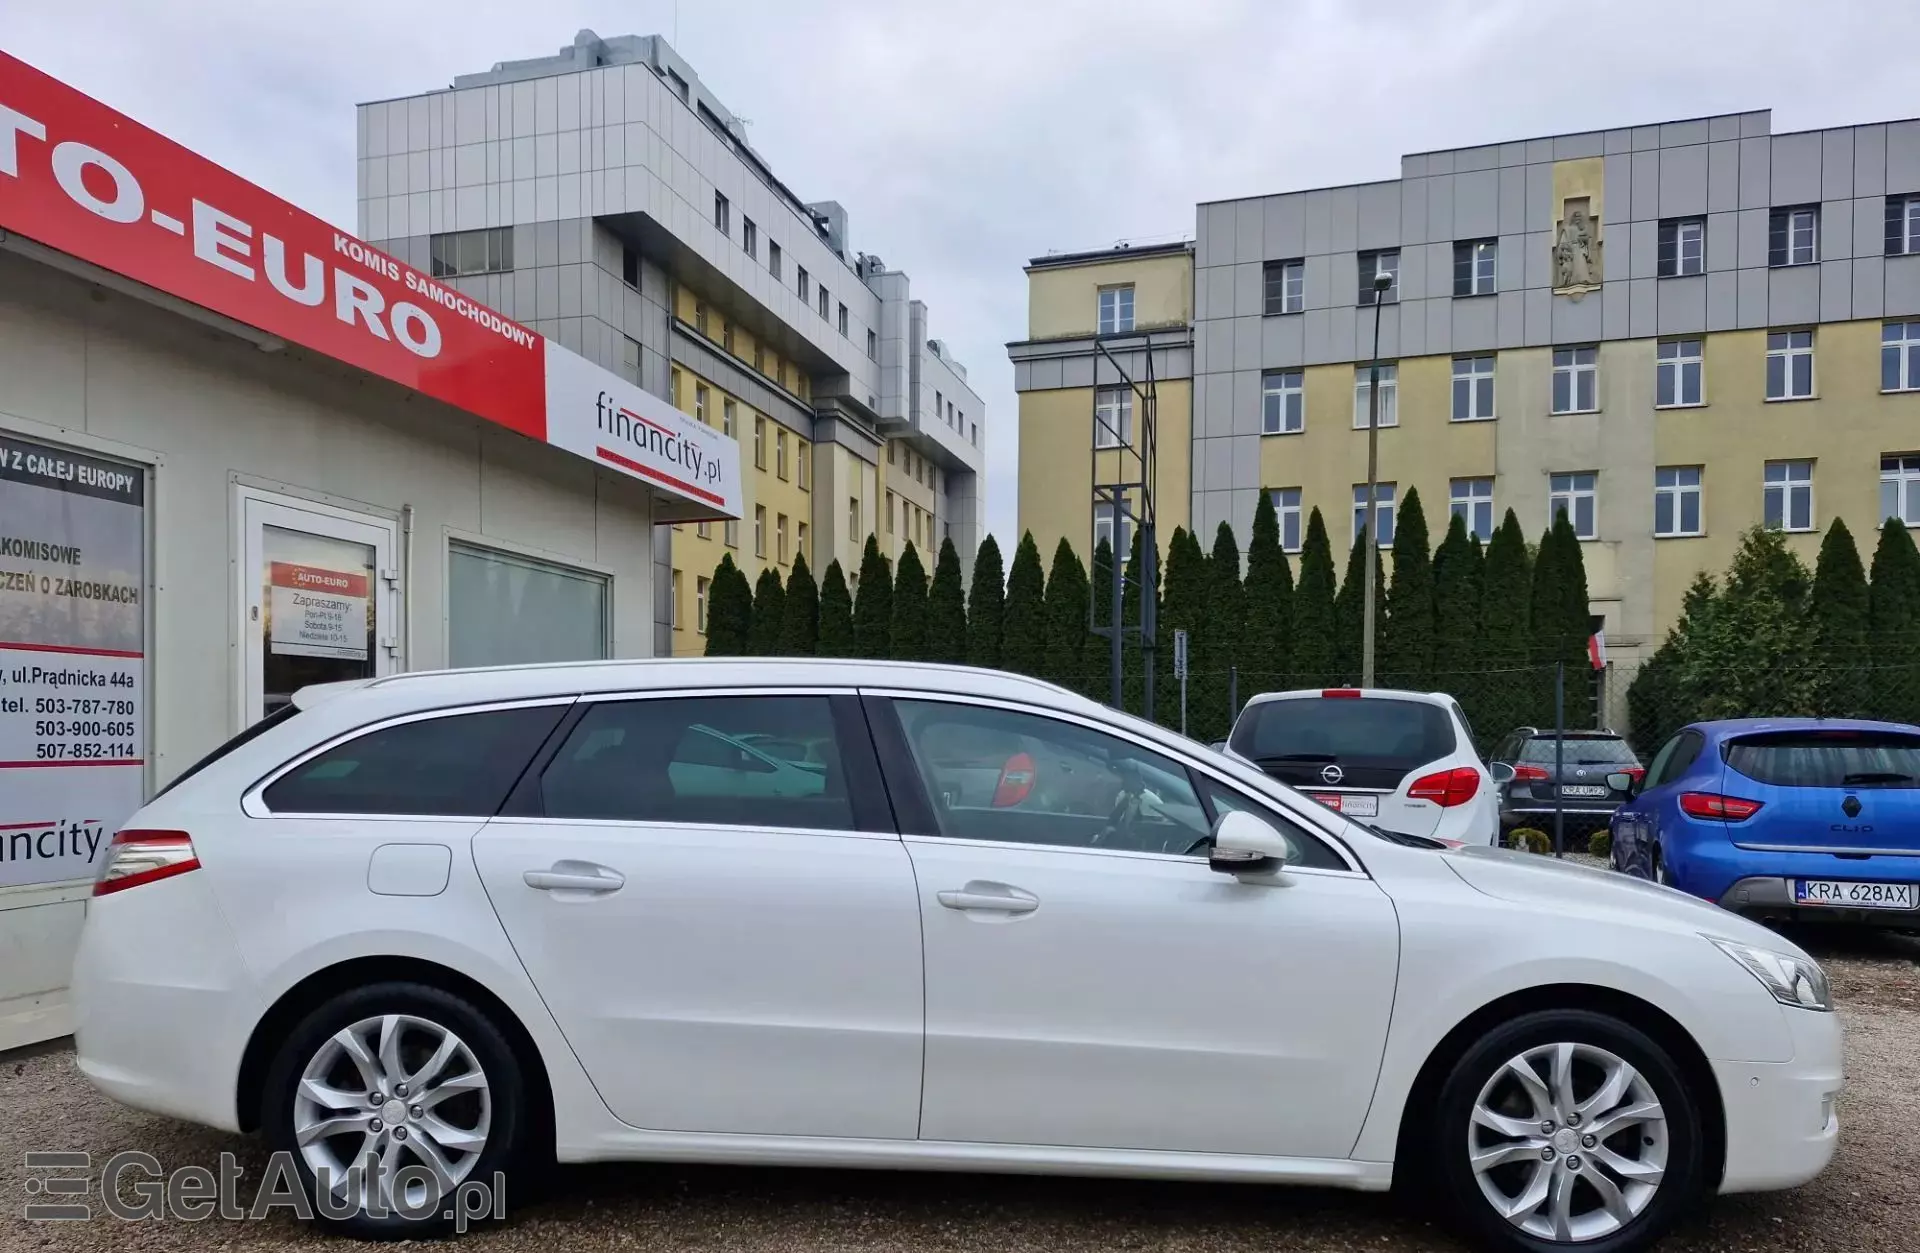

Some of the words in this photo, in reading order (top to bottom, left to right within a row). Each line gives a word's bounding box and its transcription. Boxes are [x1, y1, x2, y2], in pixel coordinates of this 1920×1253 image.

[0, 104, 442, 358] TO-EURO
[333, 233, 400, 281] KOMIS
[405, 271, 536, 350] SAMOCHODOWY
[596, 391, 722, 484] financity.pl
[12, 450, 23, 470] Z
[27, 454, 74, 481] CAŁEJ
[78, 465, 134, 493] EUROPY
[0, 536, 81, 565] KOMISOWE
[41, 576, 50, 593] O
[55, 578, 138, 604] ZAROBKACH
[297, 573, 349, 588] AUTO-EURO
[292, 593, 353, 614] Zapraszamy:
[305, 620, 327, 630] Sobota
[110, 671, 135, 688] 44a
[1, 697, 29, 713] tel.
[35, 697, 135, 715] 503-787-780
[35, 720, 135, 736] 503-900-605
[36, 743, 135, 759] 507-852-114
[1830, 824, 1874, 832] CLIO
[1806, 882, 1843, 900] KRA
[1849, 884, 1908, 903] 628AX
